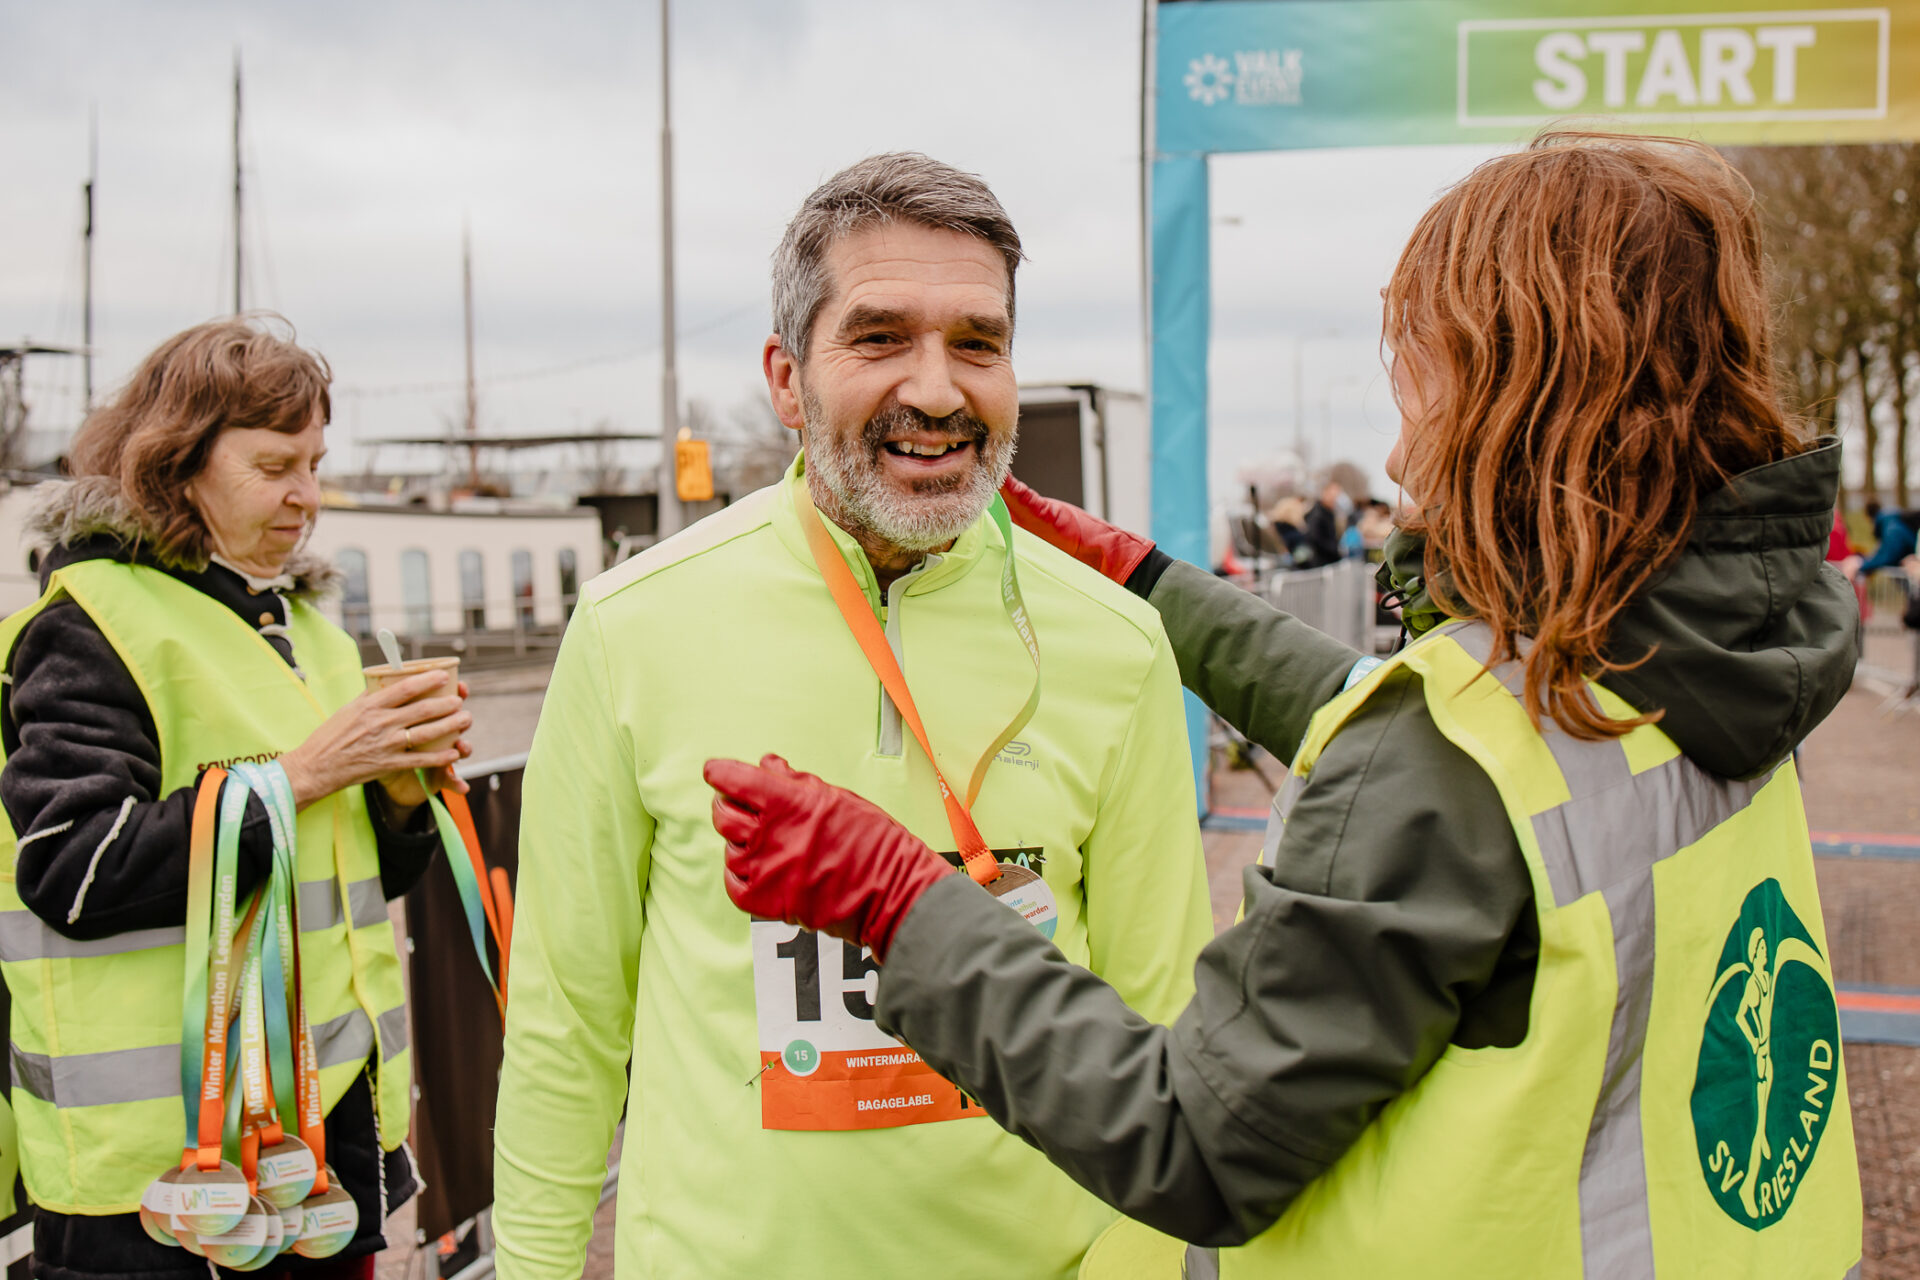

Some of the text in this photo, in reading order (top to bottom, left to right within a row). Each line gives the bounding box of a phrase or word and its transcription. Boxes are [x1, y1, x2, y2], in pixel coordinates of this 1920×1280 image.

[1533, 26, 1816, 109] START
[204, 874, 233, 1101] Winter Marathon Leeuwarden
[244, 956, 262, 1044] Leeuwarden
[244, 1047, 266, 1116] Marathon
[794, 1050, 809, 1062] 15
[846, 1053, 924, 1068] WINTERMARA
[306, 1078, 321, 1129] Winter
[857, 1094, 934, 1111] BAGAGELABEL
[1708, 1038, 1834, 1217] SV RIESLAND
